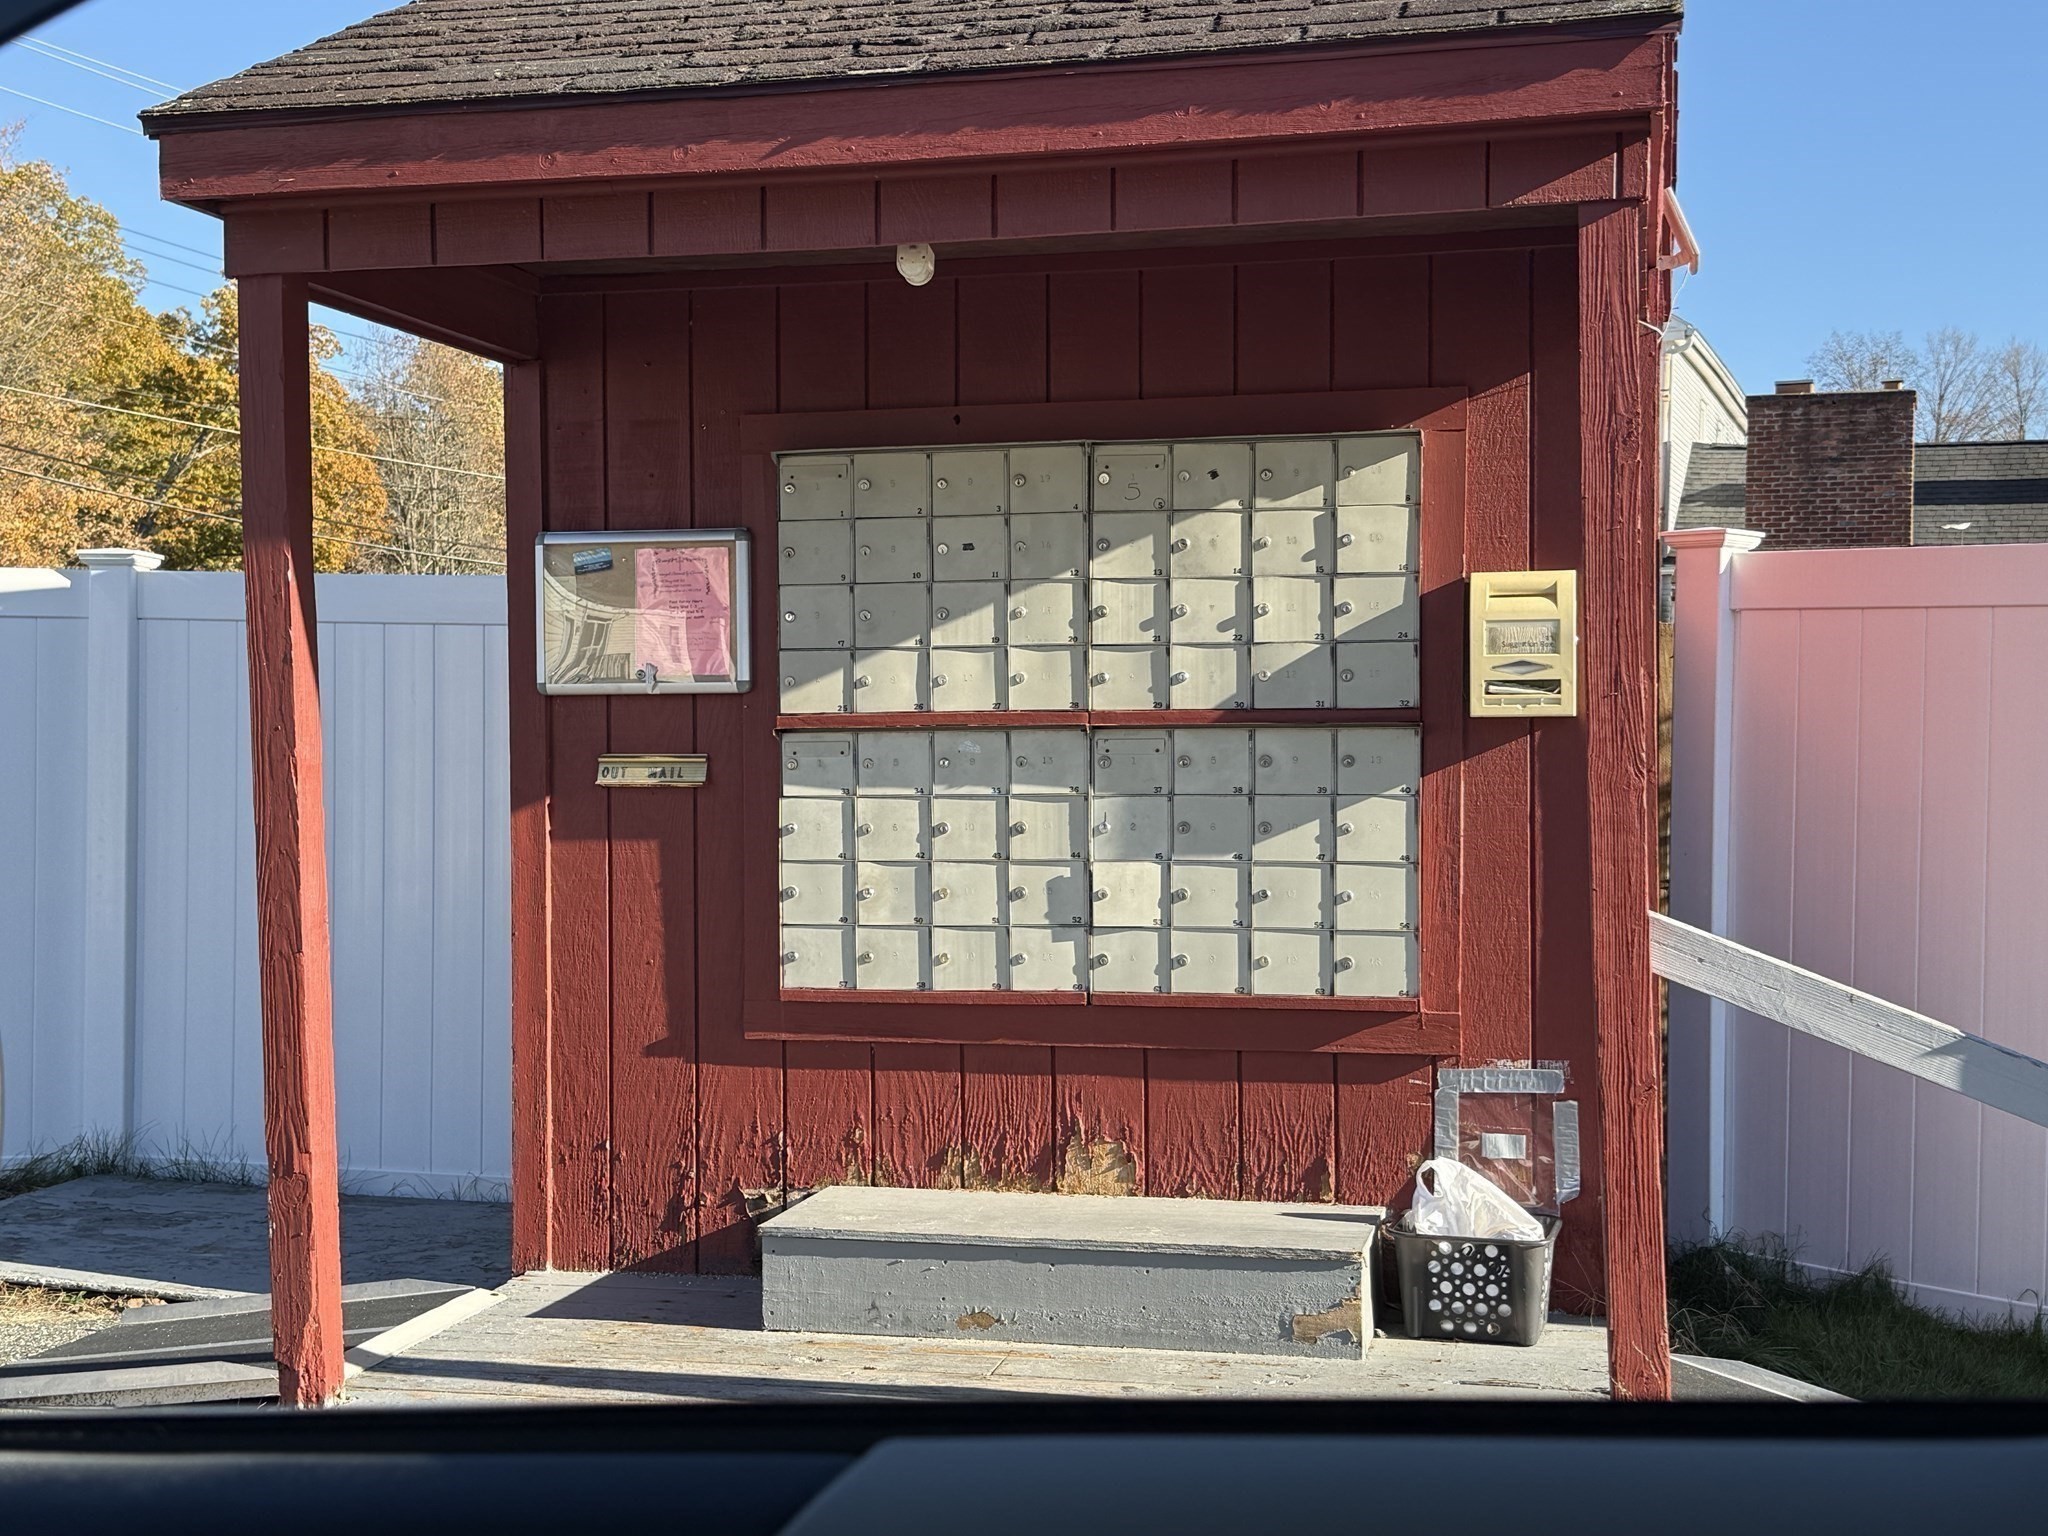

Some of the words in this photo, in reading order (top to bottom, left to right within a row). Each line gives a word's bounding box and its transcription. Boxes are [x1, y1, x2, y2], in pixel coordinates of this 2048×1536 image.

[1124, 482, 1141, 501] 5
[1235, 701, 1244, 709] 30
[601, 766, 628, 779] OUT
[647, 766, 684, 779] MAIL
[841, 788, 850, 796] 33
[1233, 786, 1243, 794] 38
[1317, 786, 1327, 794] 39
[1400, 786, 1411, 794] 40
[992, 983, 1002, 991] 59
